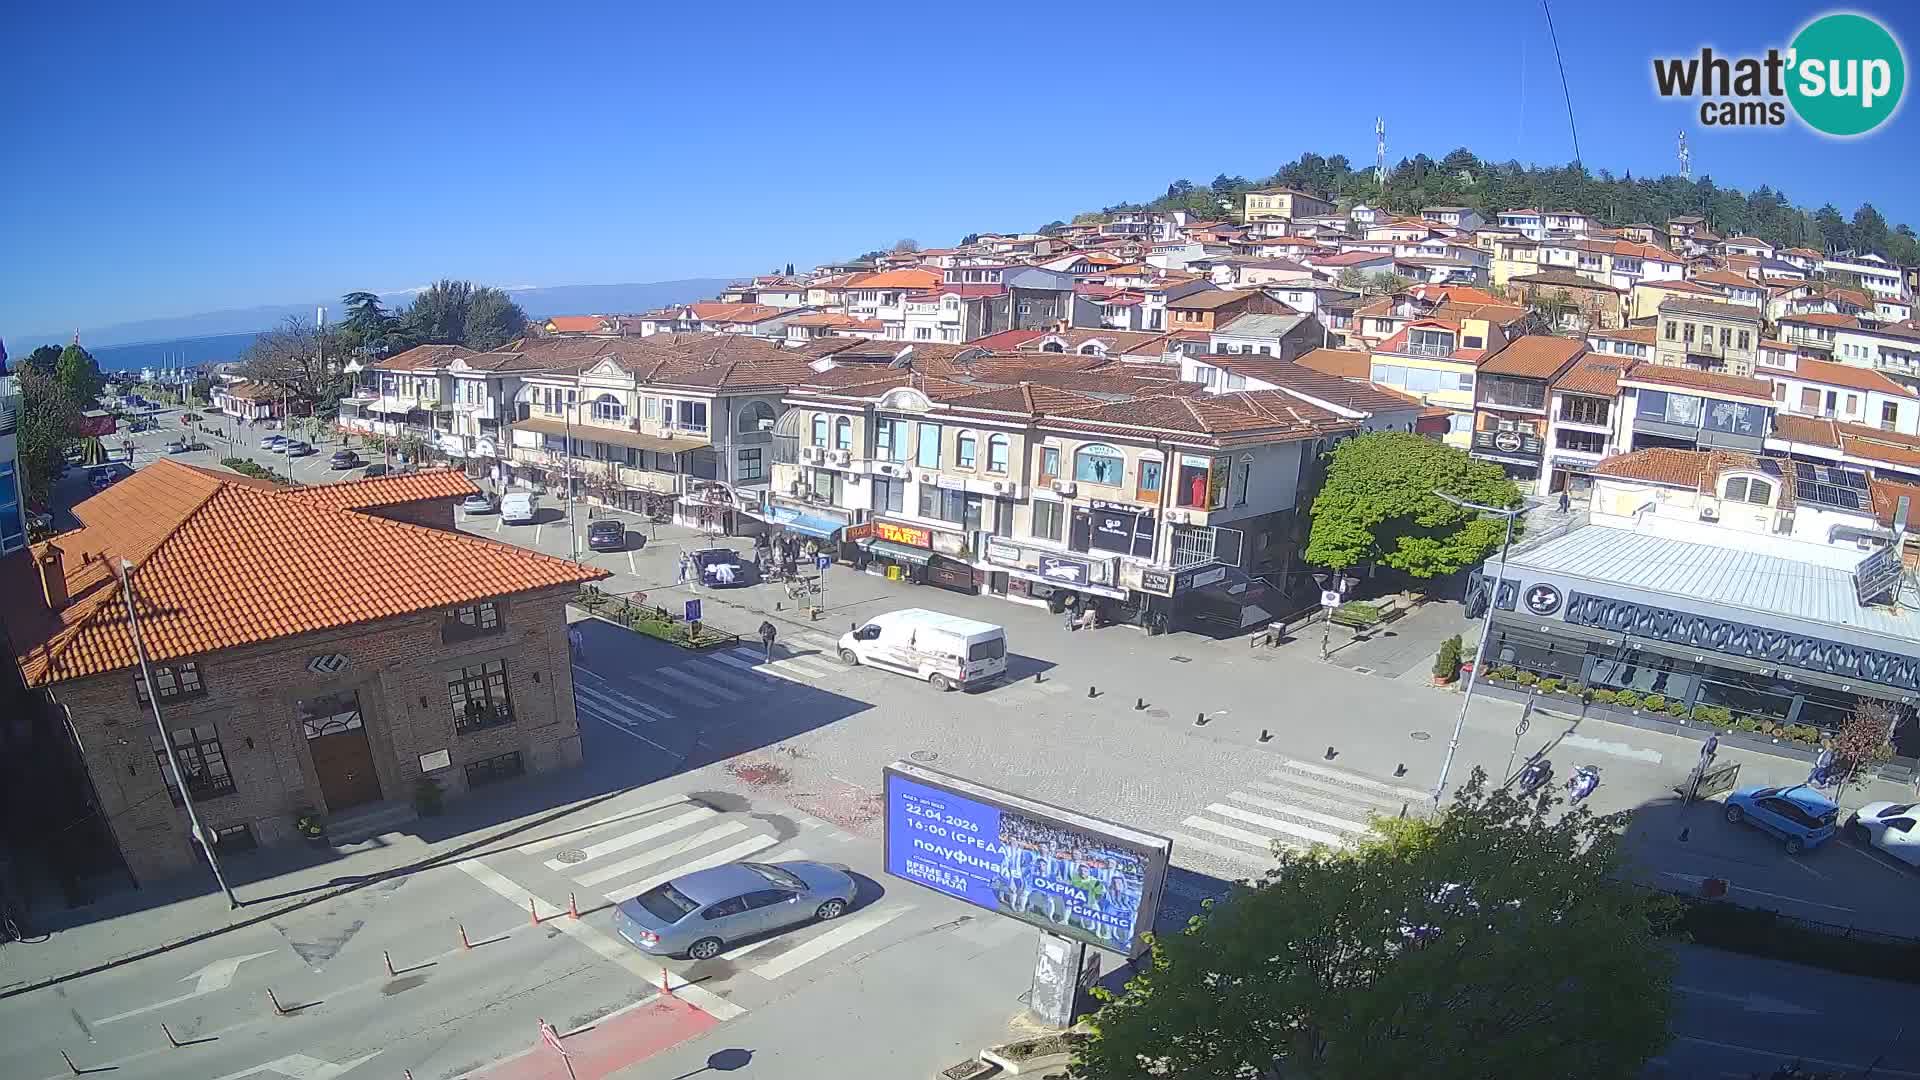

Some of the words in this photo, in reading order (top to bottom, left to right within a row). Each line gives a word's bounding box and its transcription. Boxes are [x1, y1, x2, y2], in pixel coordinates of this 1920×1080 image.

[820, 558, 827, 568] P
[905, 803, 980, 832] 22.04.2026
[906, 817, 947, 837] 16:00
[906, 859, 942, 877] ВРЕМЕ
[1034, 876, 1087, 902] ОХРИД
[1073, 906, 1129, 927] СИЛЕКС
